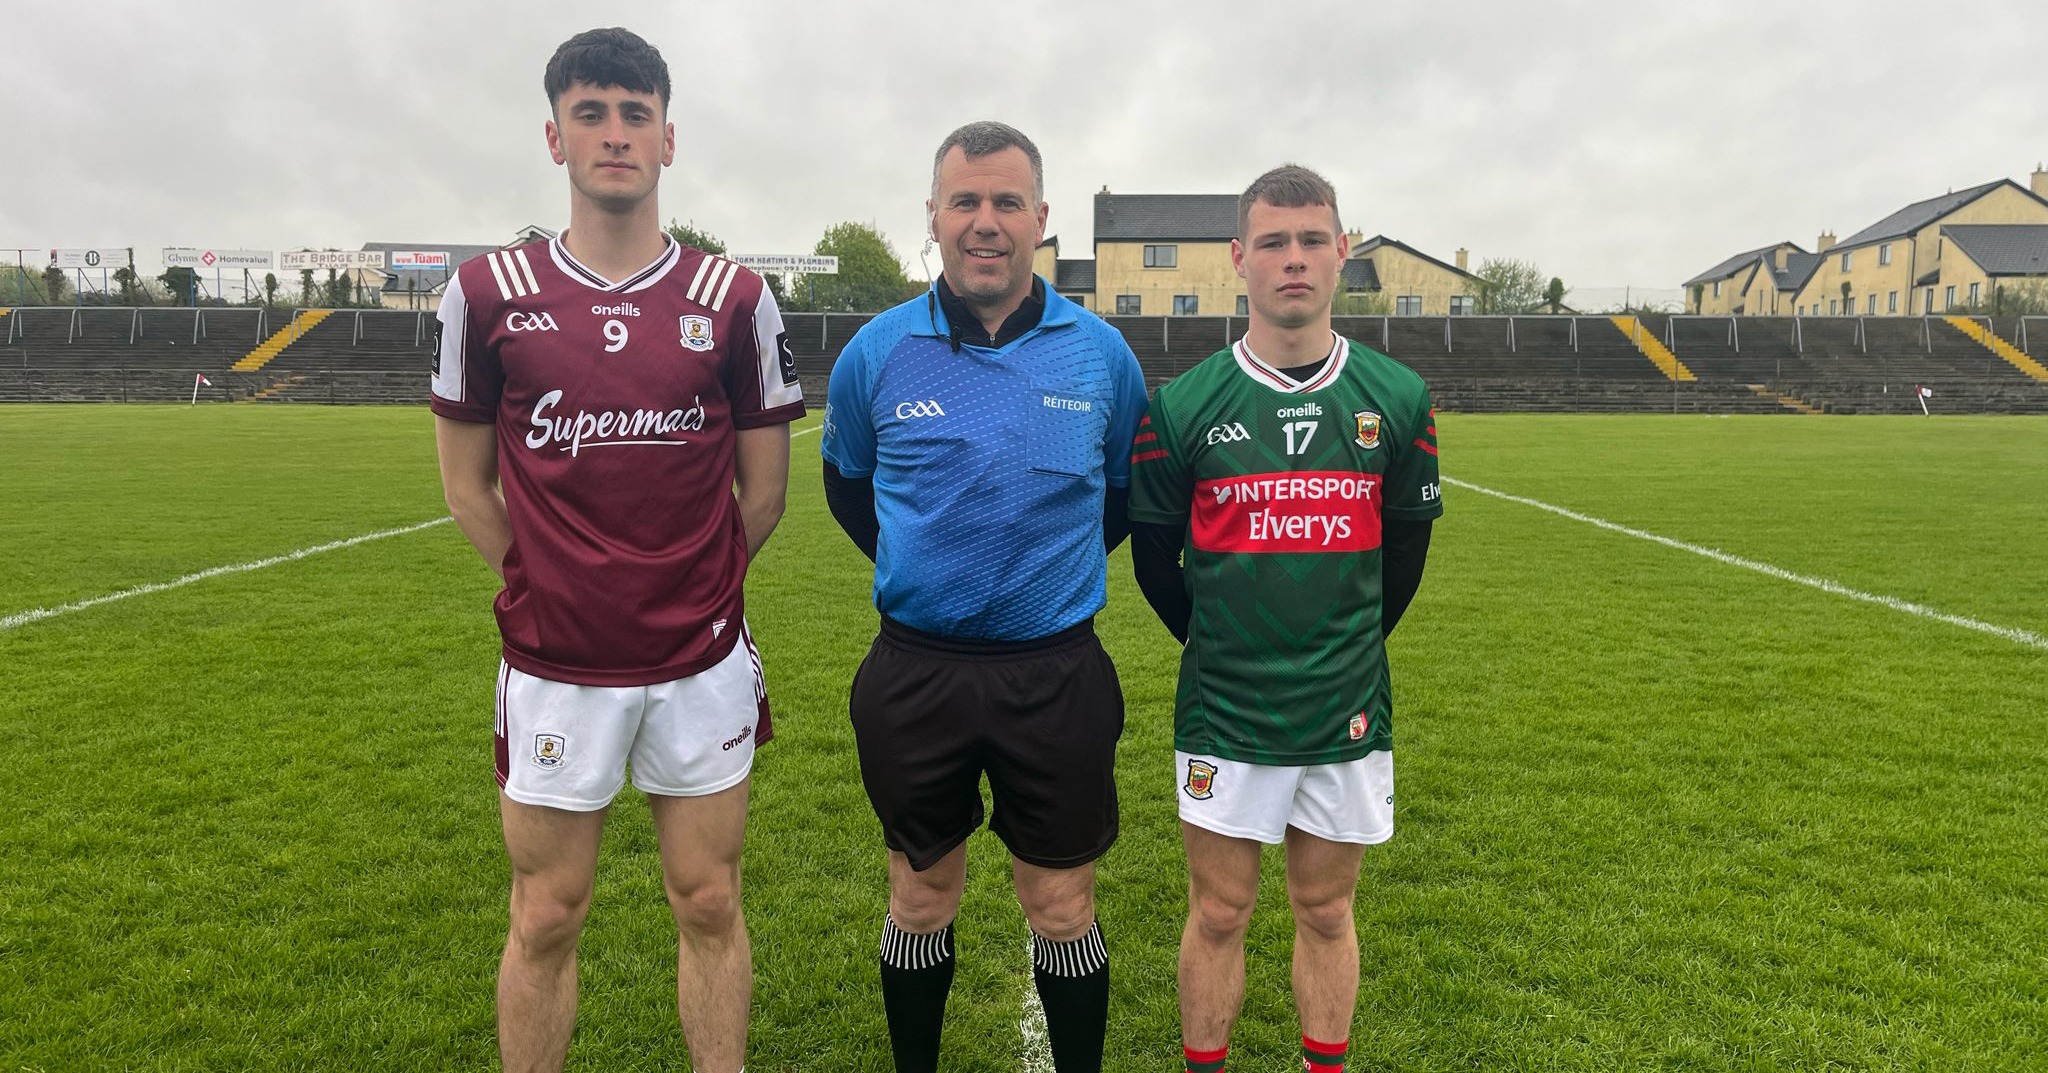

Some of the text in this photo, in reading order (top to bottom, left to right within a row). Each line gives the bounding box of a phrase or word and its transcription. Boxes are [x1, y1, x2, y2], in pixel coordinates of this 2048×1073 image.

[168, 253, 268, 263] Glynns Homevalue
[283, 253, 382, 263] THE BRIDGE BAR
[506, 312, 559, 332] GAA
[603, 319, 629, 353] 9
[895, 400, 946, 420] GAA
[1043, 395, 1091, 413] RÉITEOIR
[525, 389, 706, 458] Supermac's
[1207, 422, 1252, 446] GAA
[1282, 421, 1319, 455] 17
[1235, 477, 1376, 504] INTERSPORT
[1249, 508, 1351, 546] Elverys
